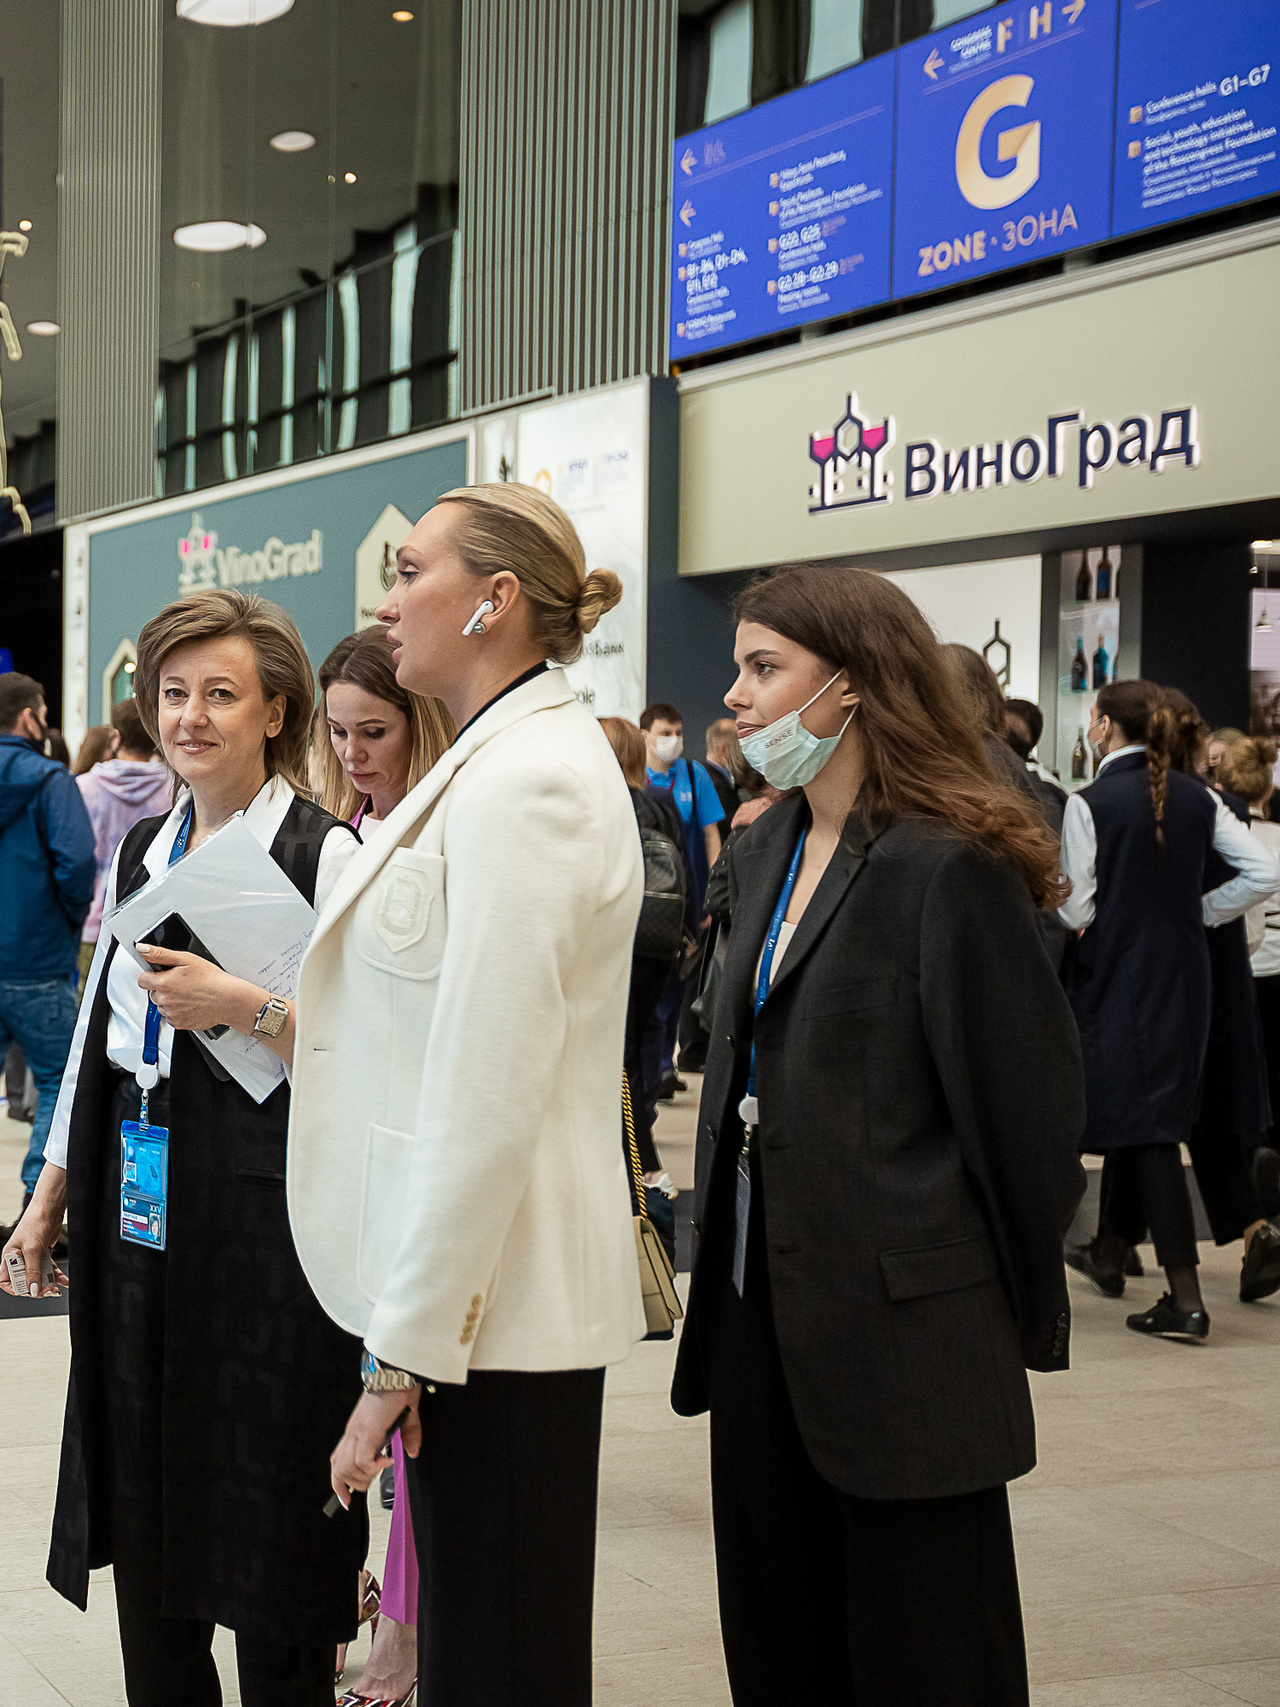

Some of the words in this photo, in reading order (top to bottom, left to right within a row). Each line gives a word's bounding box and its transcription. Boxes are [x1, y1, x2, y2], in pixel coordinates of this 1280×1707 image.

[997, 17, 1014, 53] F
[1029, 1, 1052, 40] H
[955, 74, 1041, 210] G
[918, 230, 988, 277] ZONE
[904, 405, 1199, 500] ВиноГрад
[217, 529, 323, 585] VinoGrad
